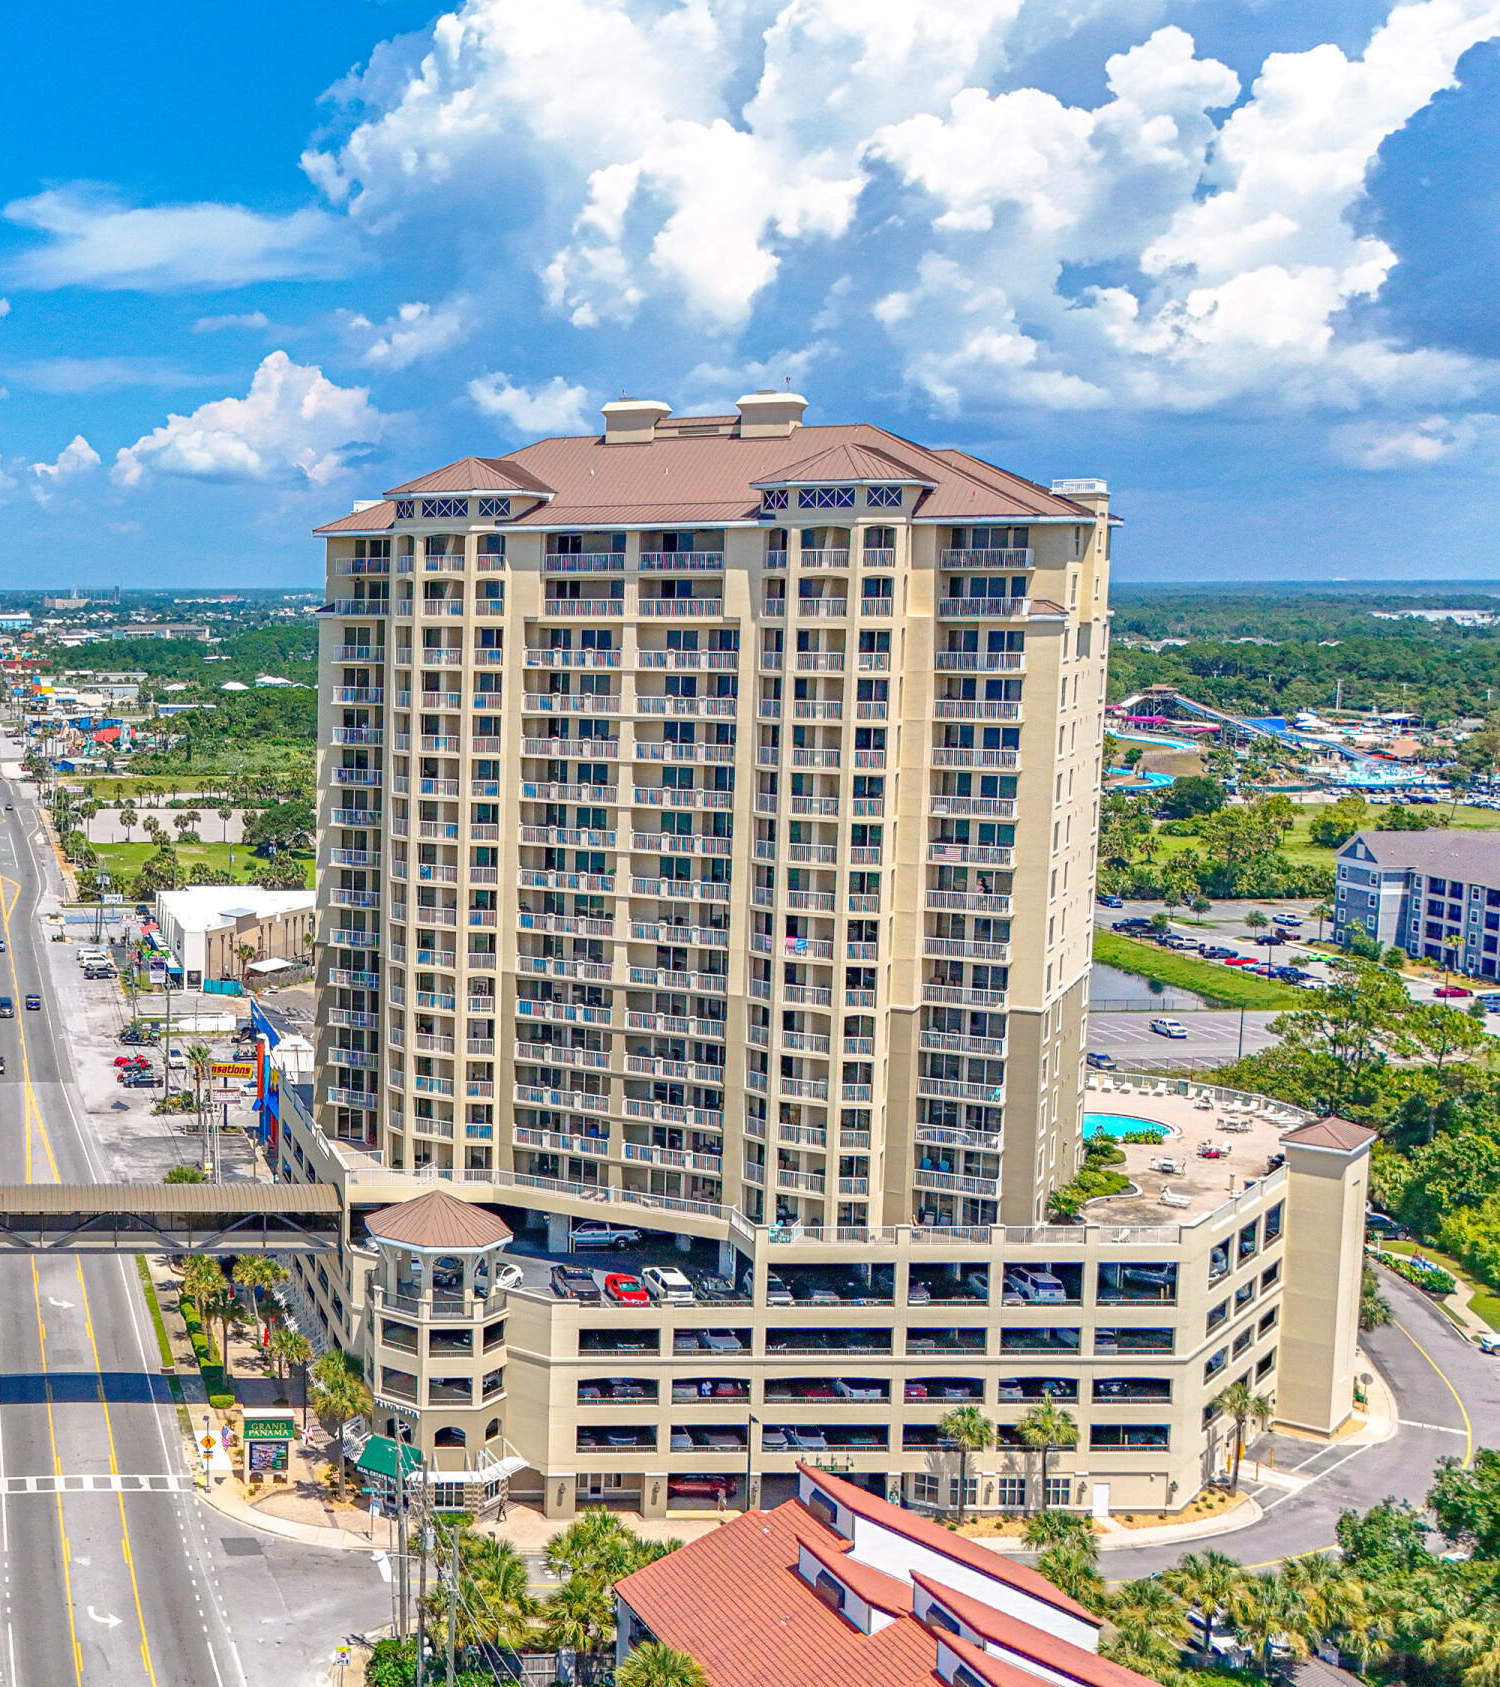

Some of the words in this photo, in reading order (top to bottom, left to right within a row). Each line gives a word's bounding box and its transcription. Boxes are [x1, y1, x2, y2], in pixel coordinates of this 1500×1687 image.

[212, 1065, 251, 1074] nsations
[251, 1422, 287, 1430] GRAND
[248, 1429, 289, 1437] PANAMA
[357, 1466, 369, 1475] REAL
[369, 1470, 388, 1481] ESTATE
